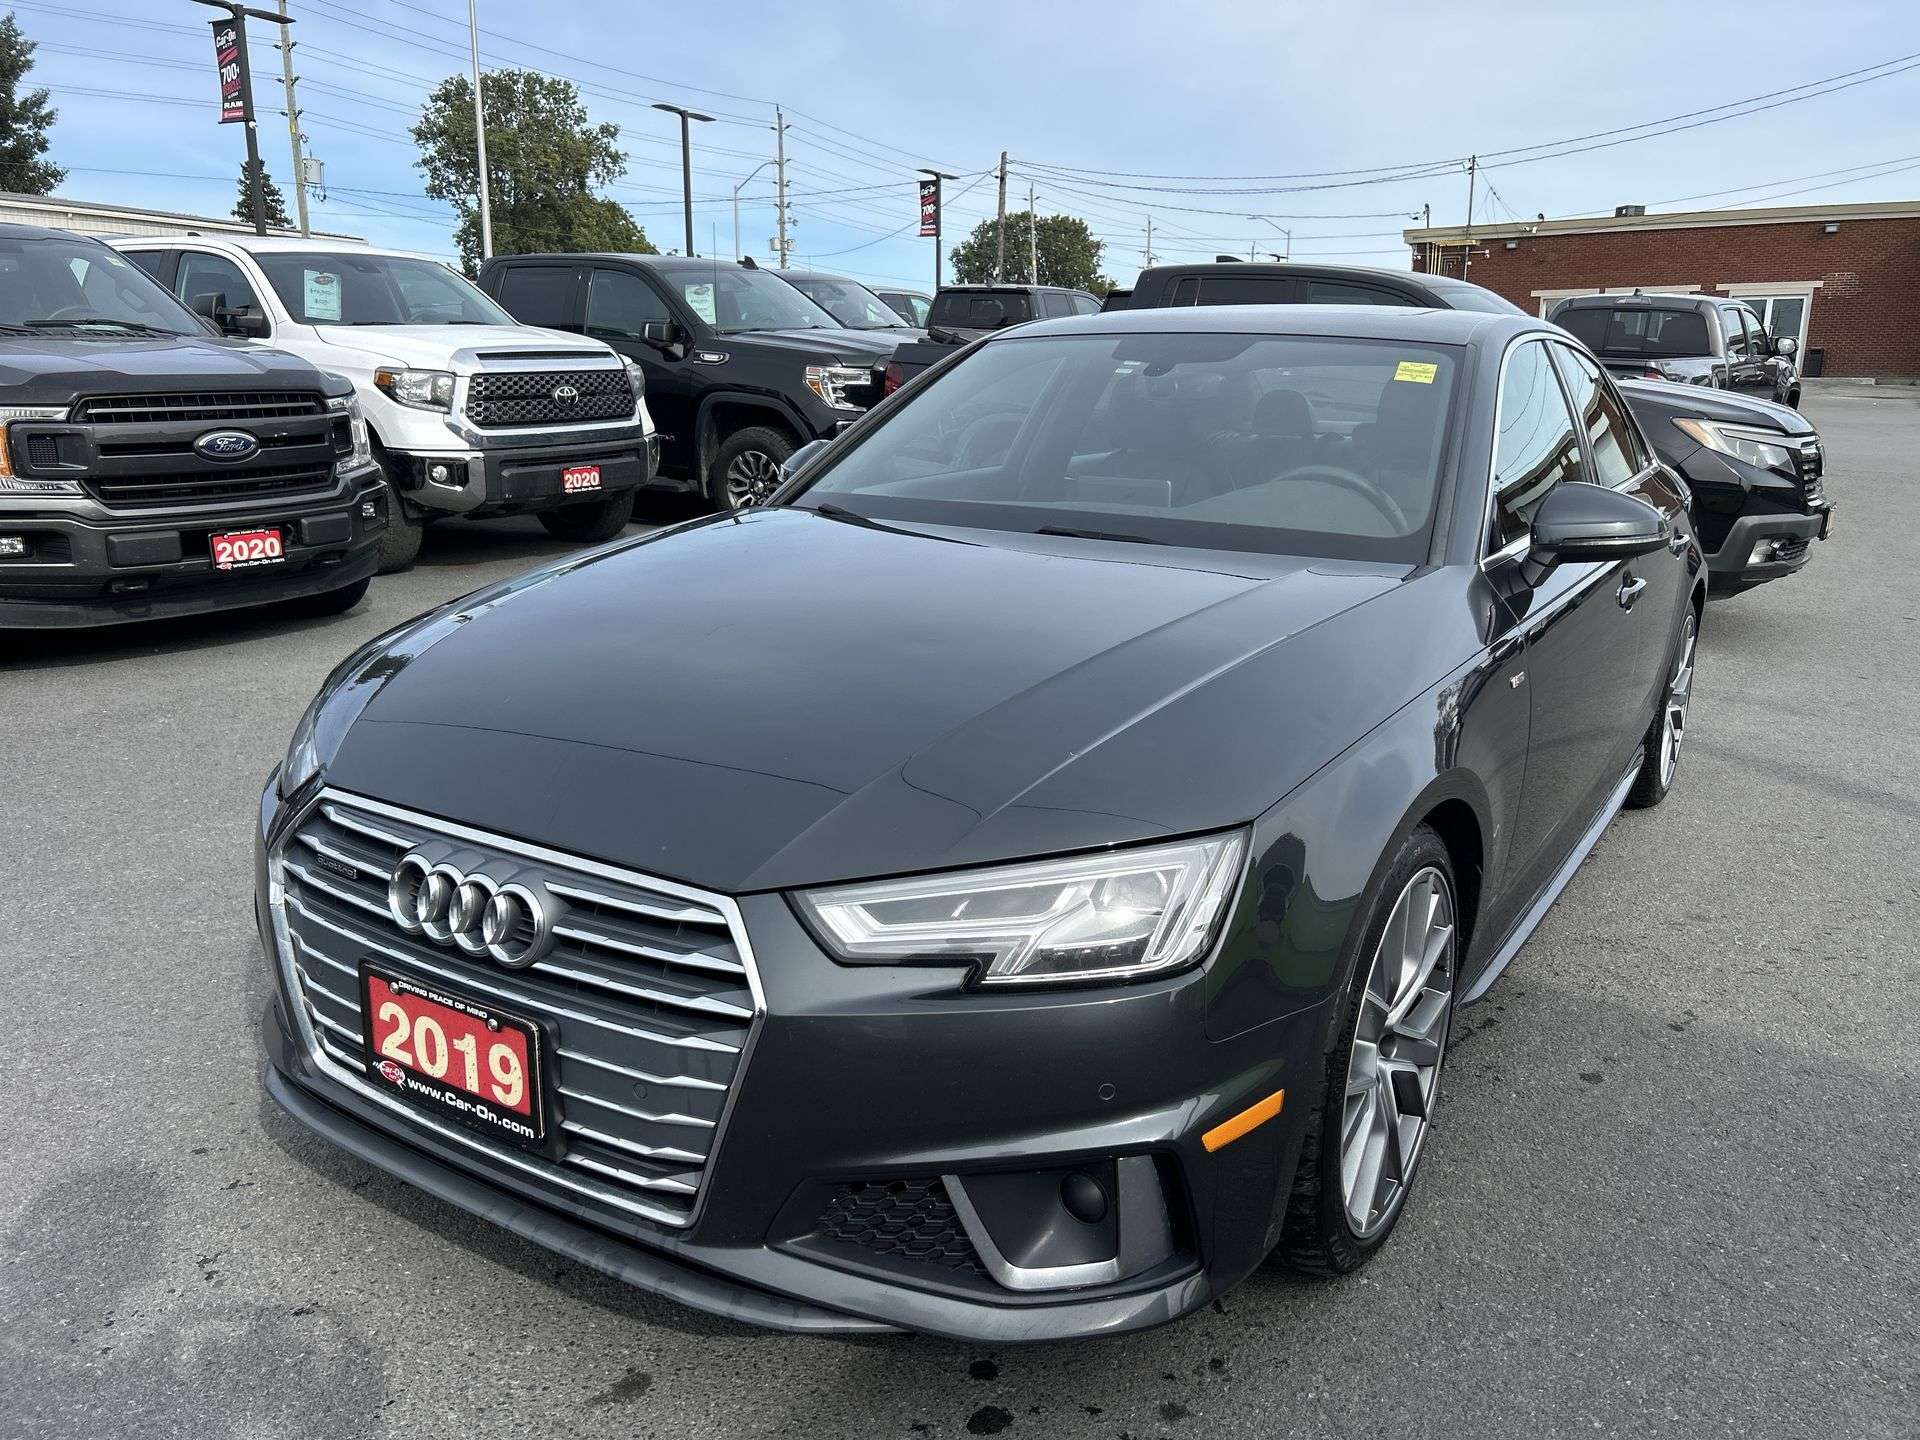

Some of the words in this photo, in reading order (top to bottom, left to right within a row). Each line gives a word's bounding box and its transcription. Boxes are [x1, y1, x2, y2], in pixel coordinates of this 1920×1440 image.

[224, 101, 243, 109] RAM
[215, 438, 244, 451] Ford
[564, 471, 600, 489] 2020
[216, 537, 281, 563] 2020
[399, 981, 428, 997] DRIVING
[428, 992, 453, 1007] PEACE
[454, 1001, 466, 1010] OF
[466, 1004, 488, 1019] MIND
[379, 1001, 524, 1107] 2019
[407, 1078, 535, 1139] www.Car-On.com
